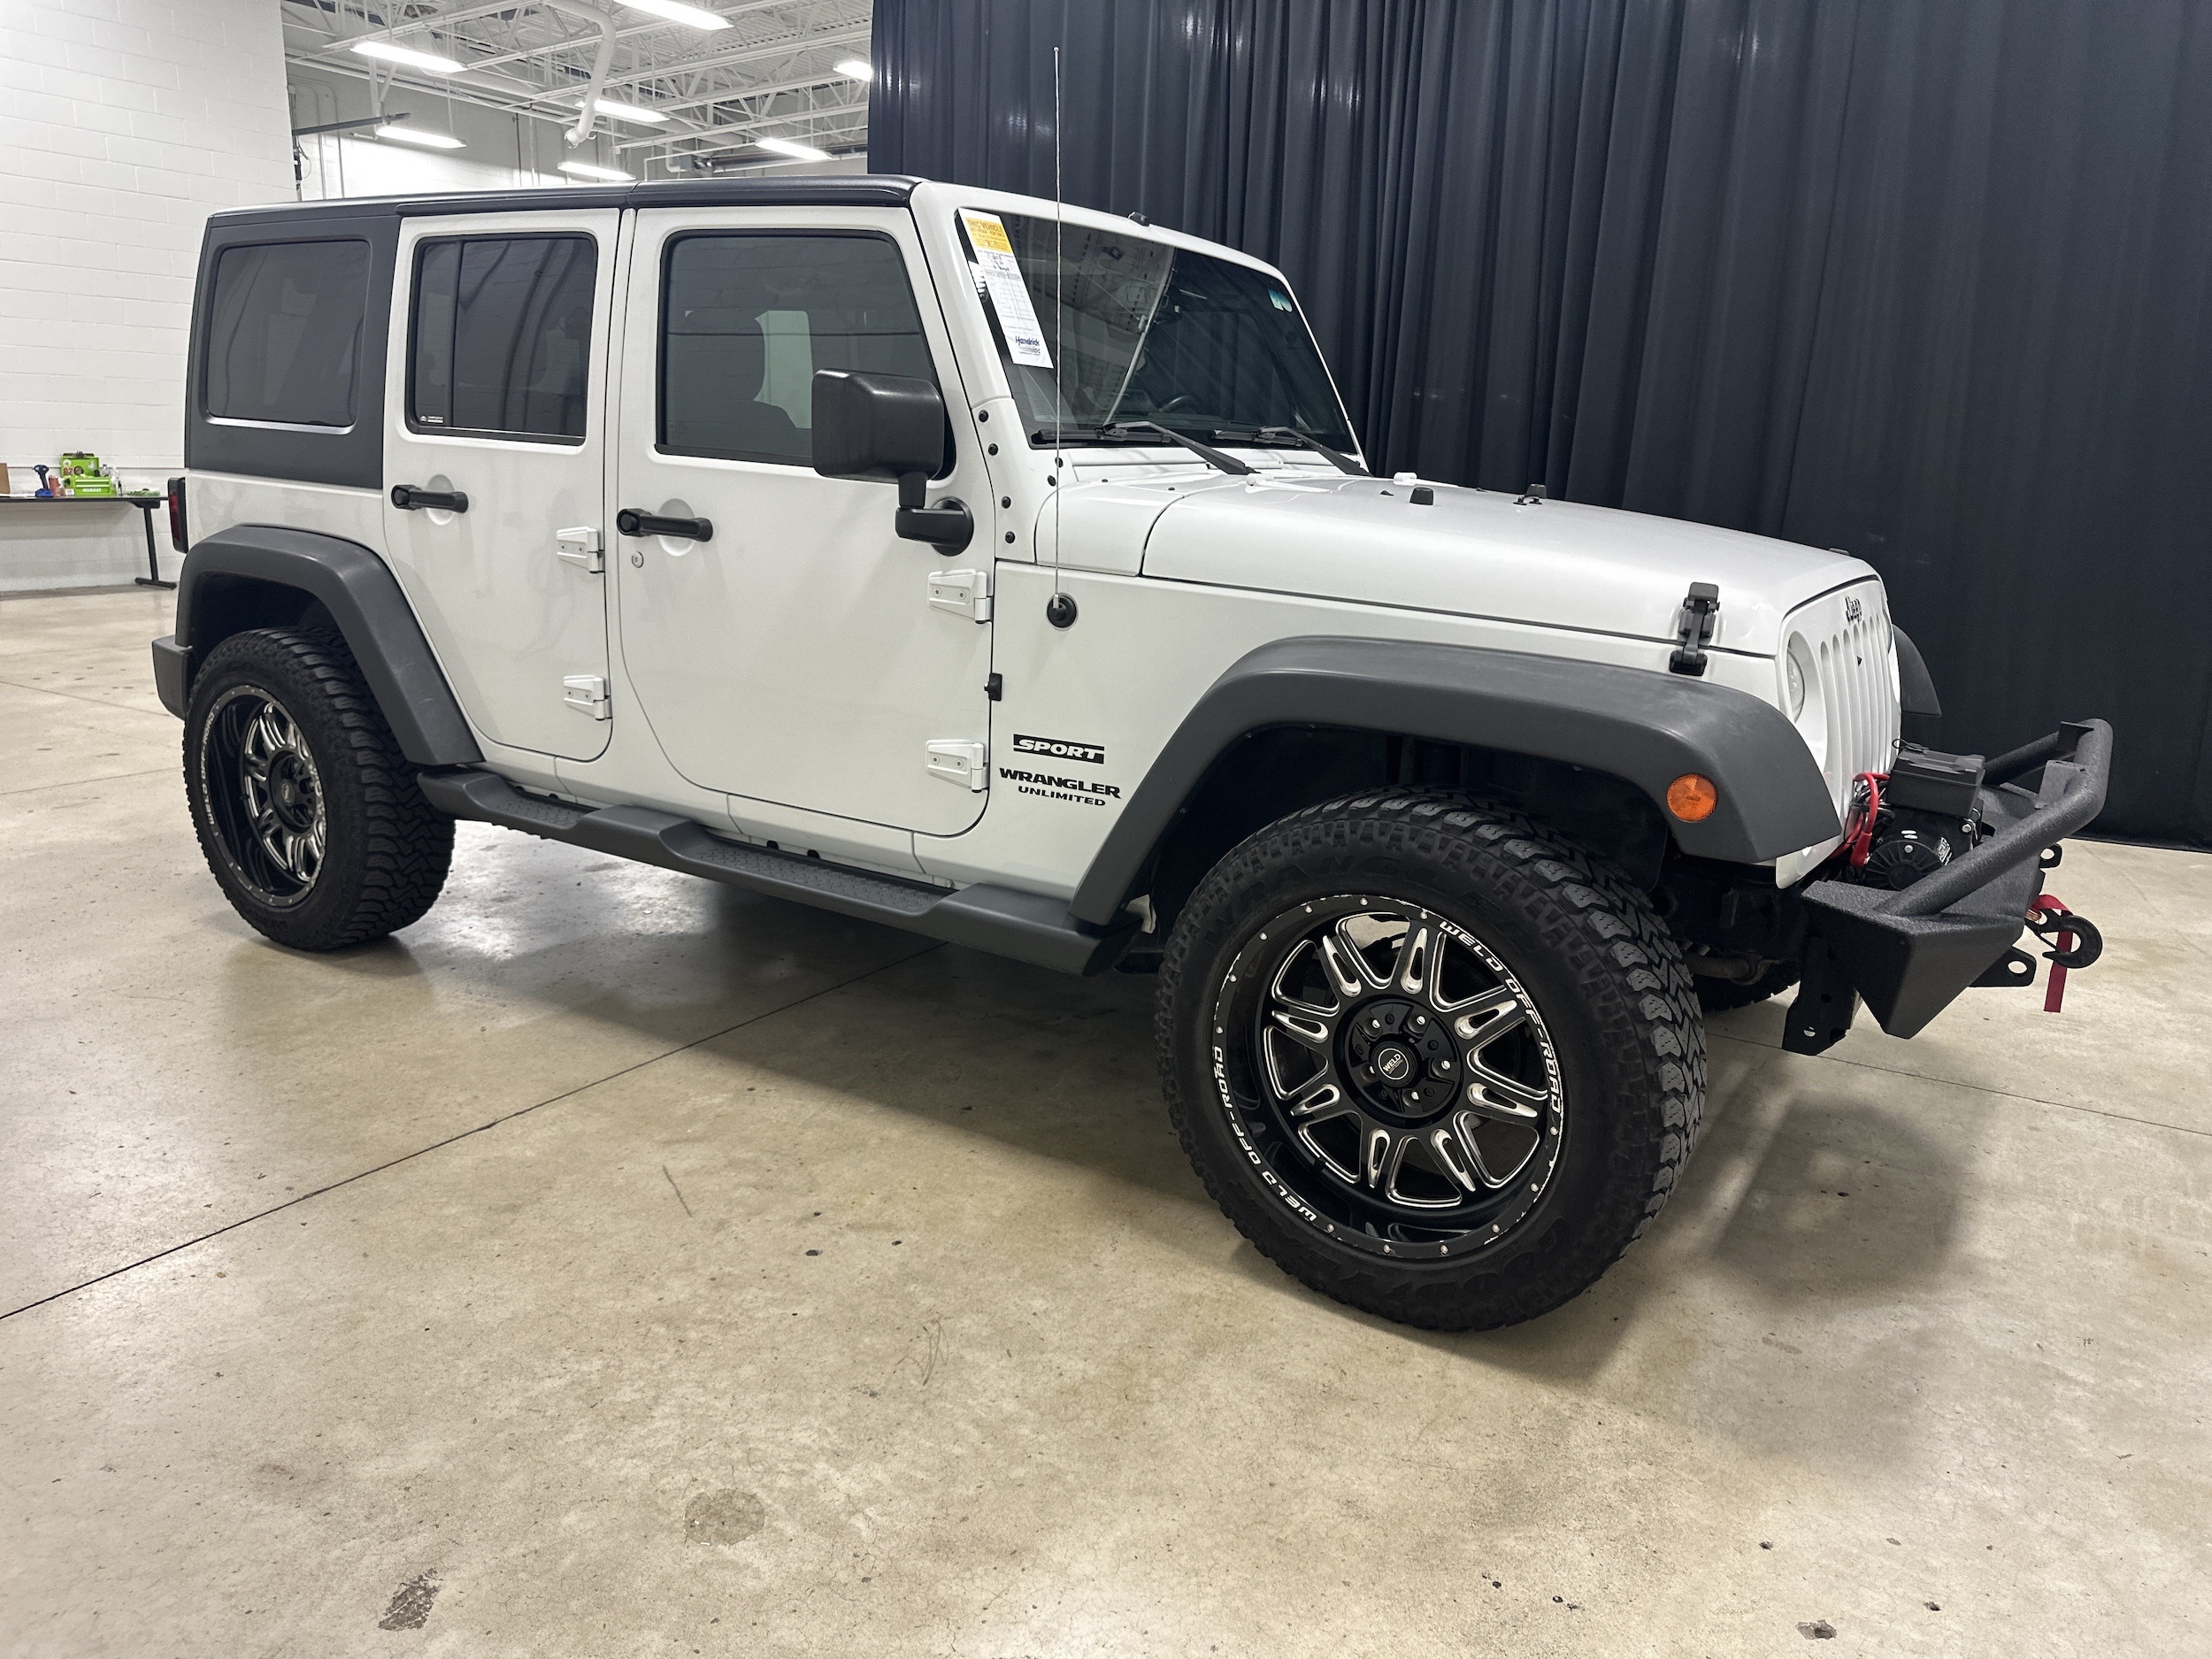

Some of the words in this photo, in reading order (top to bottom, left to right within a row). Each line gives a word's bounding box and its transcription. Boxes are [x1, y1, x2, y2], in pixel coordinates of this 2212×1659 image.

[1015, 335, 1041, 347] Hendrick
[1845, 595, 1863, 625] Jeep
[1017, 738, 1102, 760] SPORT
[999, 767, 1122, 799] WRANGLER
[1018, 786, 1106, 806] UNLIMITED
[1439, 921, 1504, 972] WELD
[1505, 978, 1562, 1114] OFF-ROAD
[1382, 1053, 1402, 1071] WELD
[1213, 1046, 1263, 1165] OFF-ROAD
[1262, 1171, 1317, 1222] WELD
